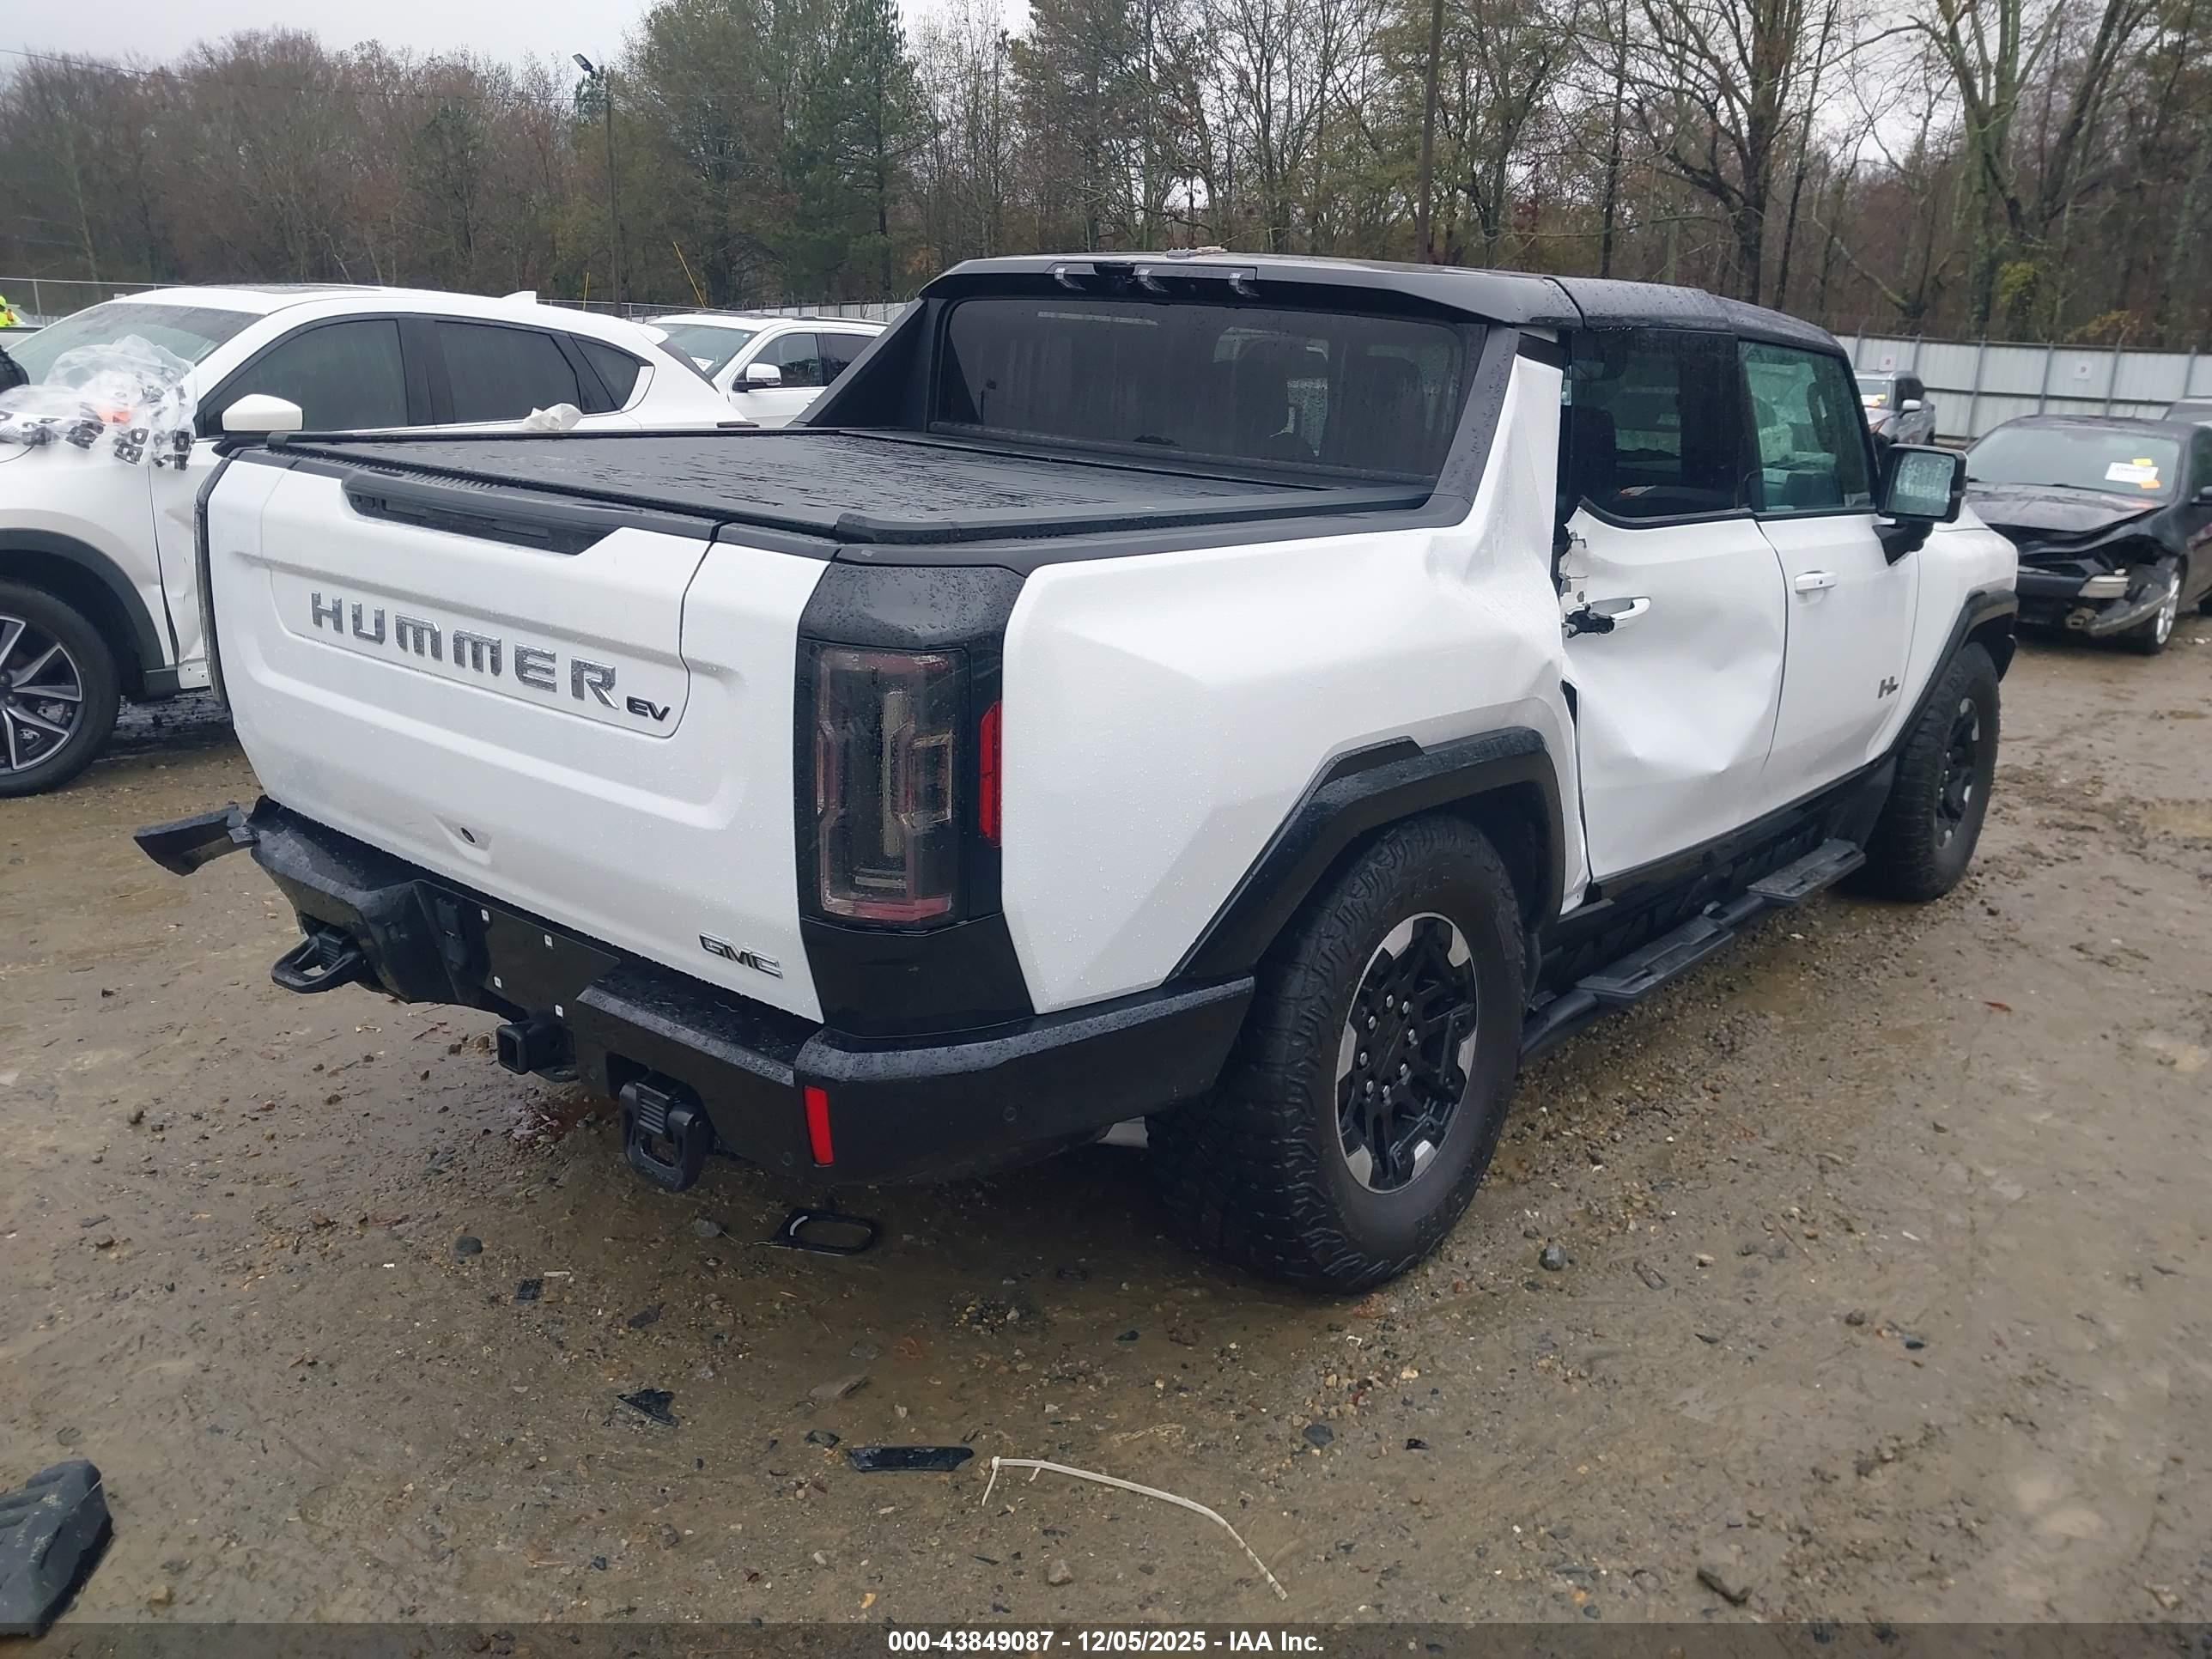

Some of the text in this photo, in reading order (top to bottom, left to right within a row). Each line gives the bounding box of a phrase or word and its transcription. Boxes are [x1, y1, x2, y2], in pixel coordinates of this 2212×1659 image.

[310, 590, 672, 722] HUMMER EV
[698, 932, 784, 980] GMC
